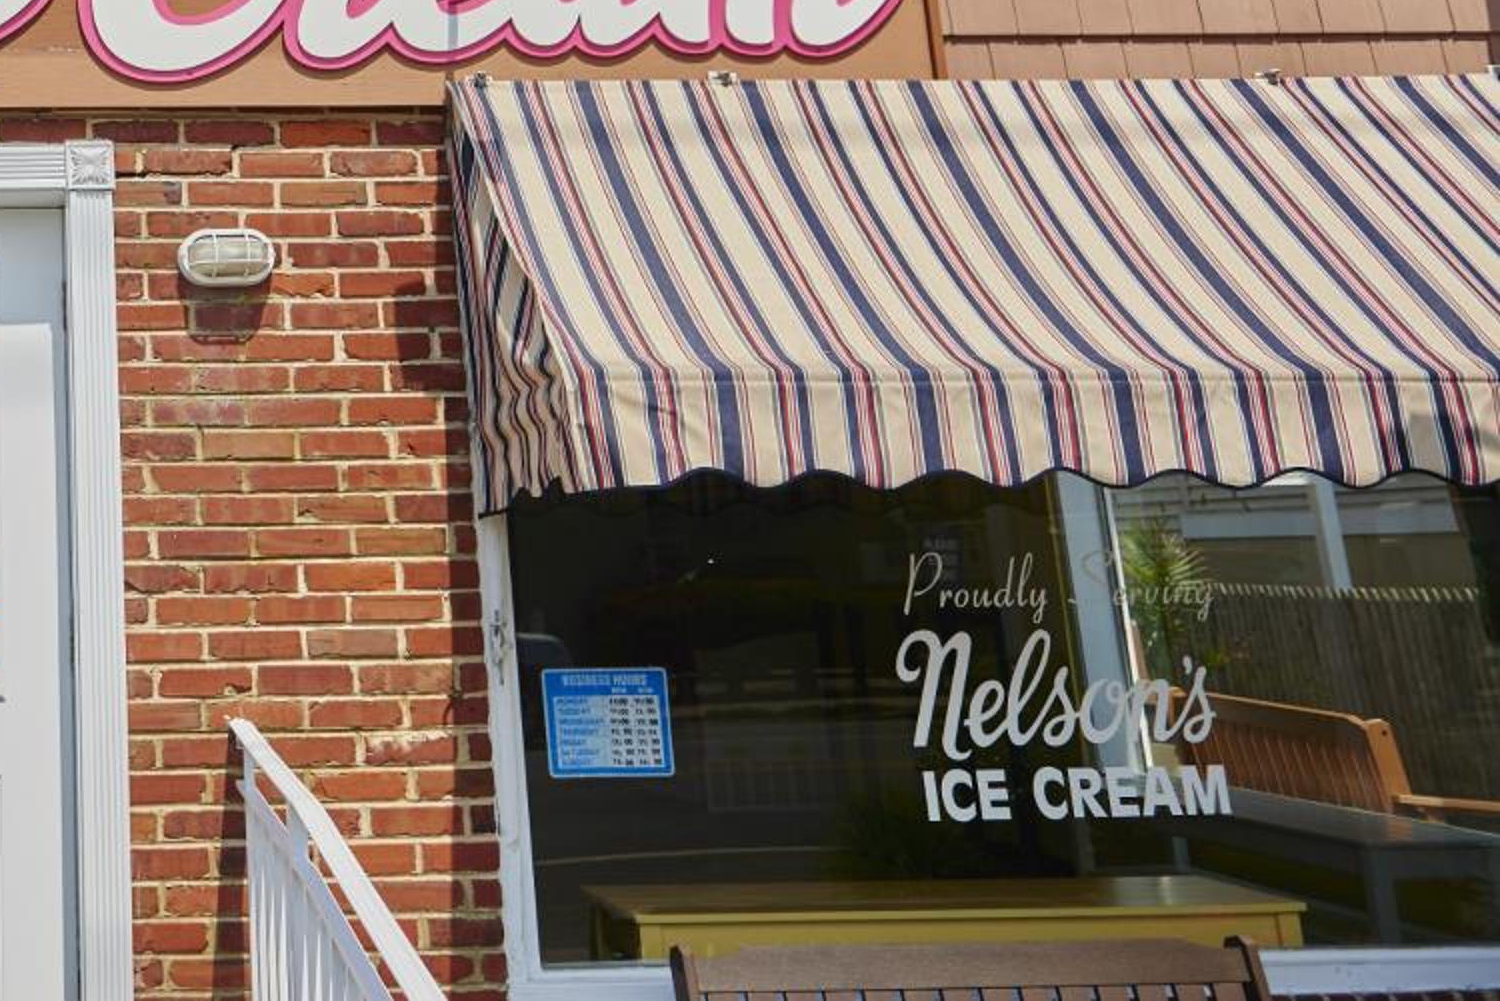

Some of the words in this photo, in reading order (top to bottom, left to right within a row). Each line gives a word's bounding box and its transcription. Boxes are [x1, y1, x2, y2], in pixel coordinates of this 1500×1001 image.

[903, 551, 1049, 624] Proudly
[895, 628, 1217, 761] Nelson's
[921, 768, 1012, 823] ICE
[1032, 765, 1233, 819] CREAM
